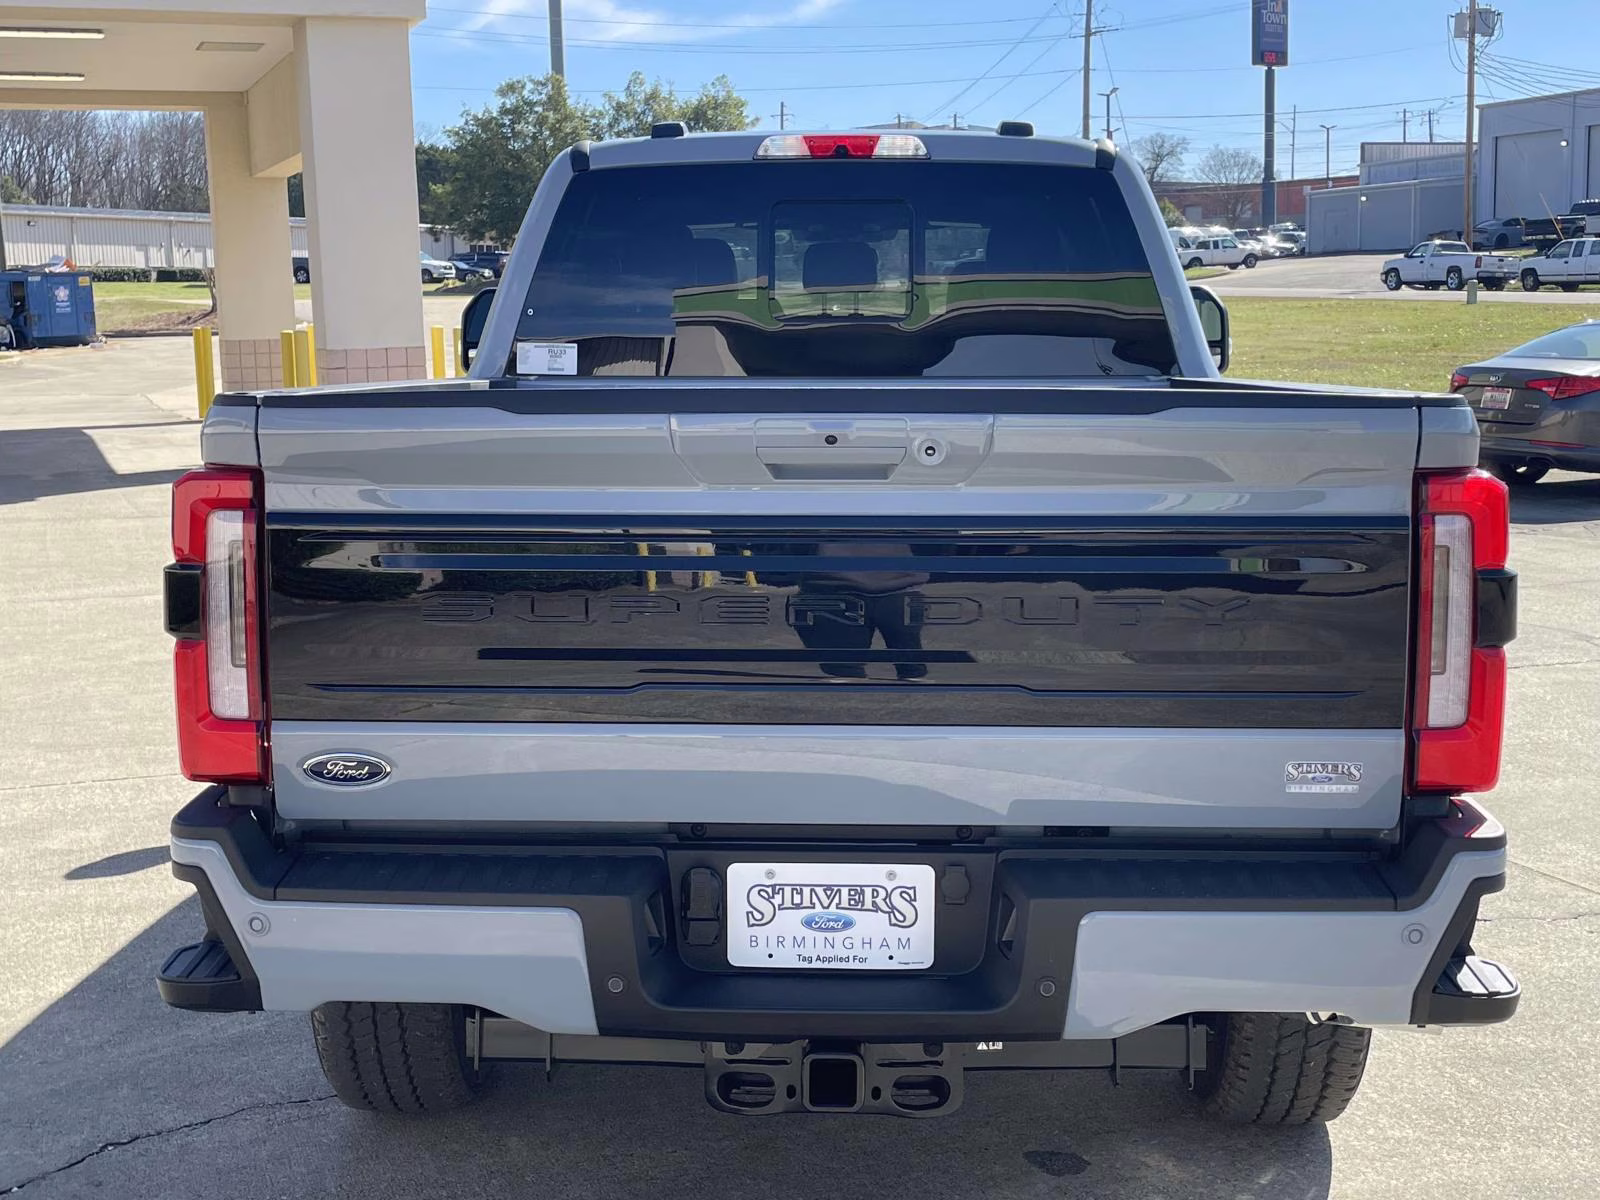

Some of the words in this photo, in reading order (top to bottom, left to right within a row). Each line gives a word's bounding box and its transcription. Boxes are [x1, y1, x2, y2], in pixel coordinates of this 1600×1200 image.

[1261, 10, 1287, 24] Town
[420, 593, 865, 625] SUPER
[904, 595, 1251, 626] DUTY
[323, 760, 369, 779] Ford
[1286, 762, 1361, 781] STIVERS
[1286, 785, 1359, 793] BIRMINGHAM
[746, 883, 918, 929] STIVERS
[811, 915, 845, 929] Ford
[749, 935, 911, 950] BIRMINGHAM
[796, 954, 813, 964] Tag
[815, 954, 850, 964] Applied
[852, 955, 868, 963] For
